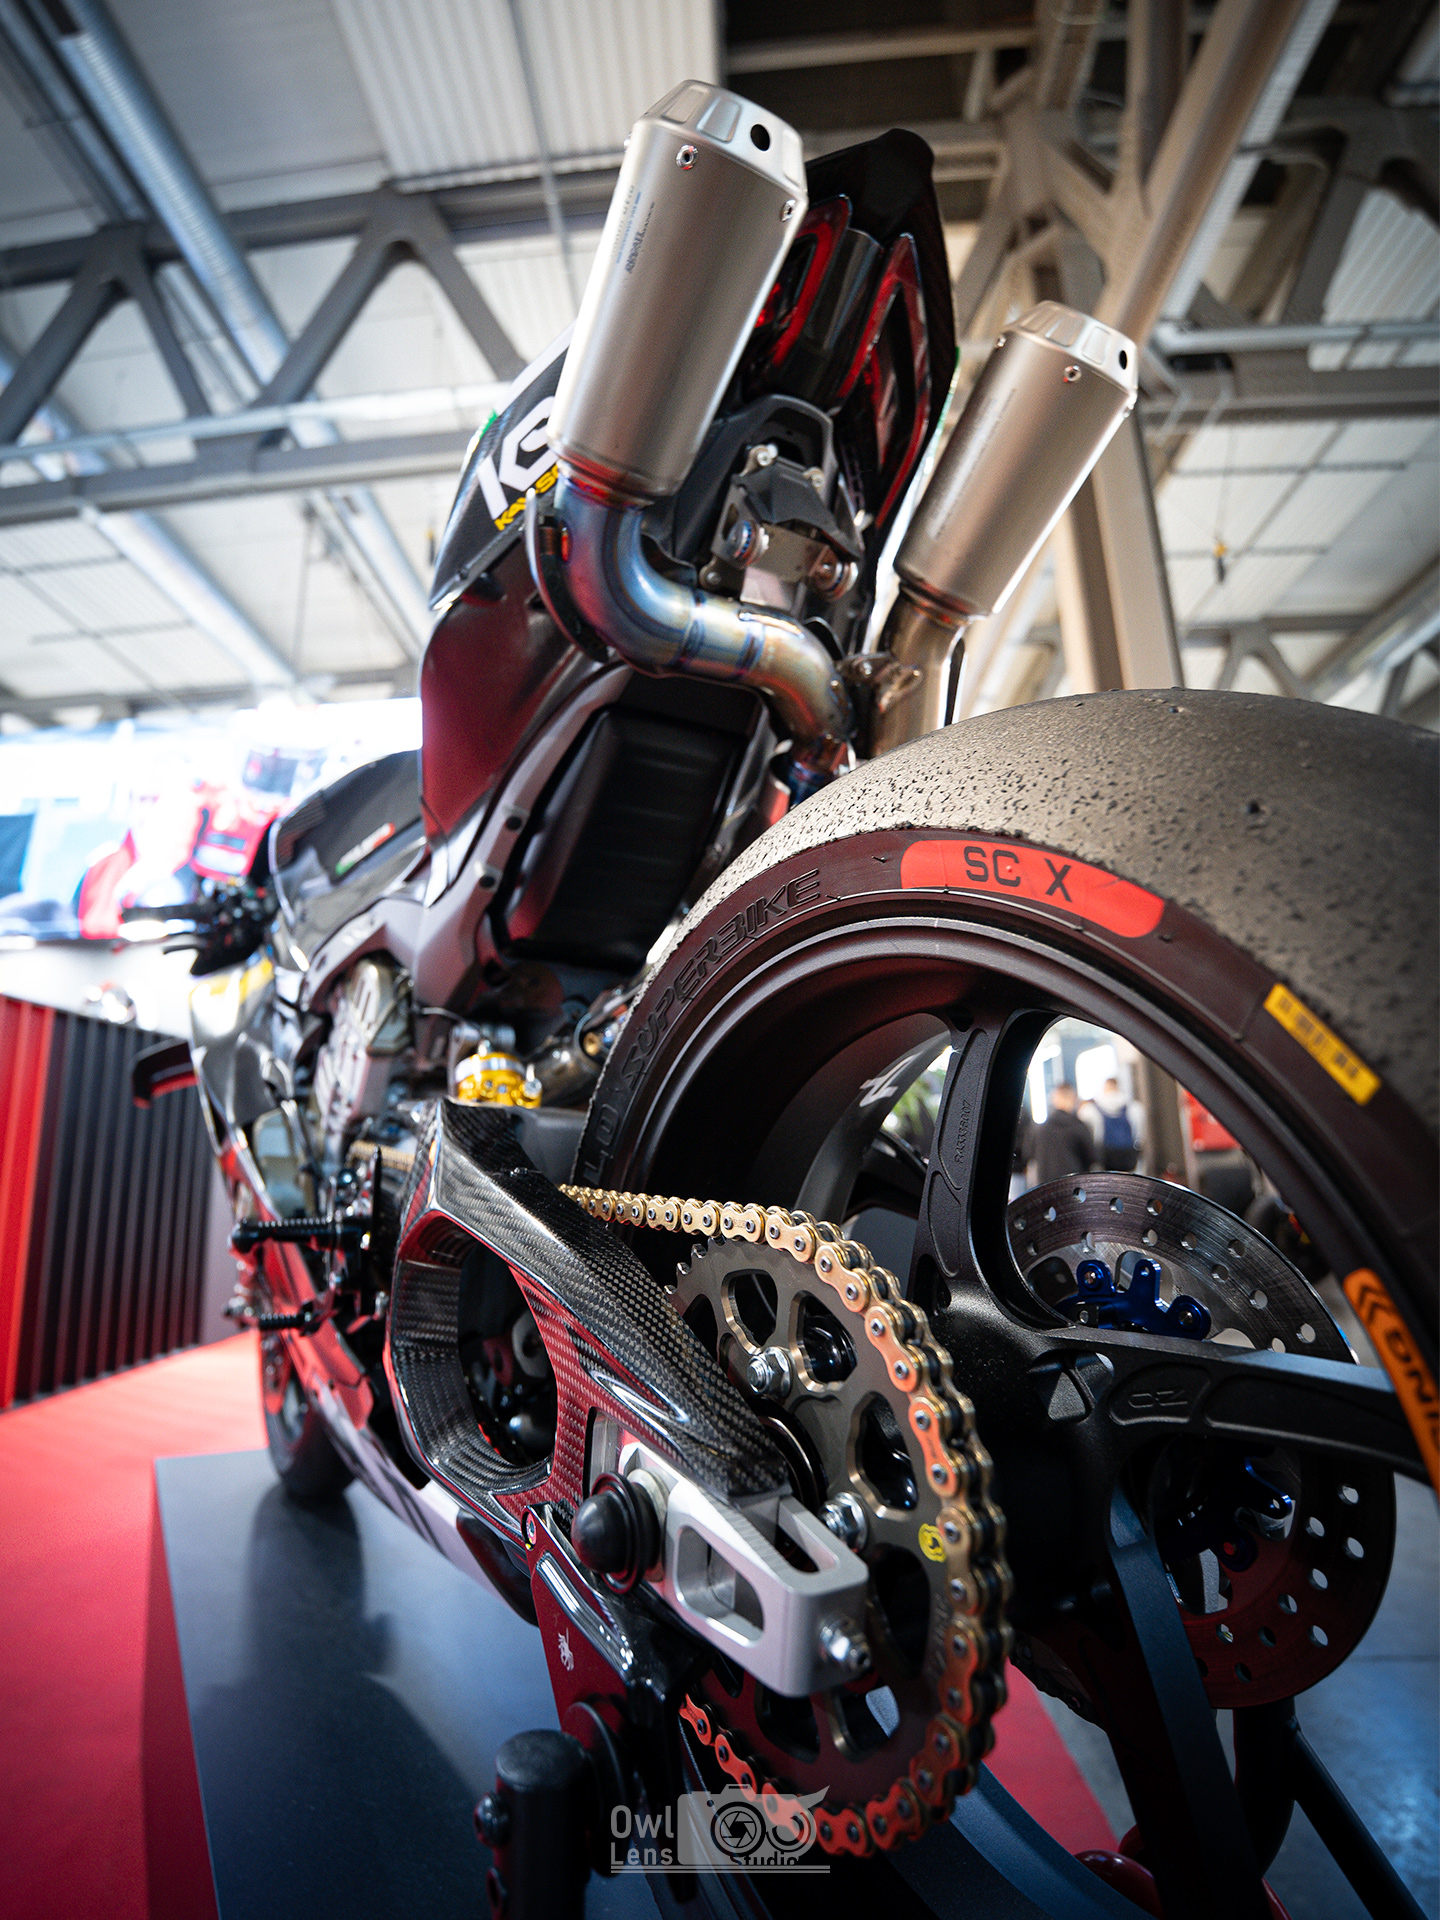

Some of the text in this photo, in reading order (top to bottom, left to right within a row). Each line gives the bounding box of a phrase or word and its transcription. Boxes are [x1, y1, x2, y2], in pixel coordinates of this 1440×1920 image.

[963, 846, 1073, 903] SC X
[620, 867, 821, 1091] SUPERBIKE
